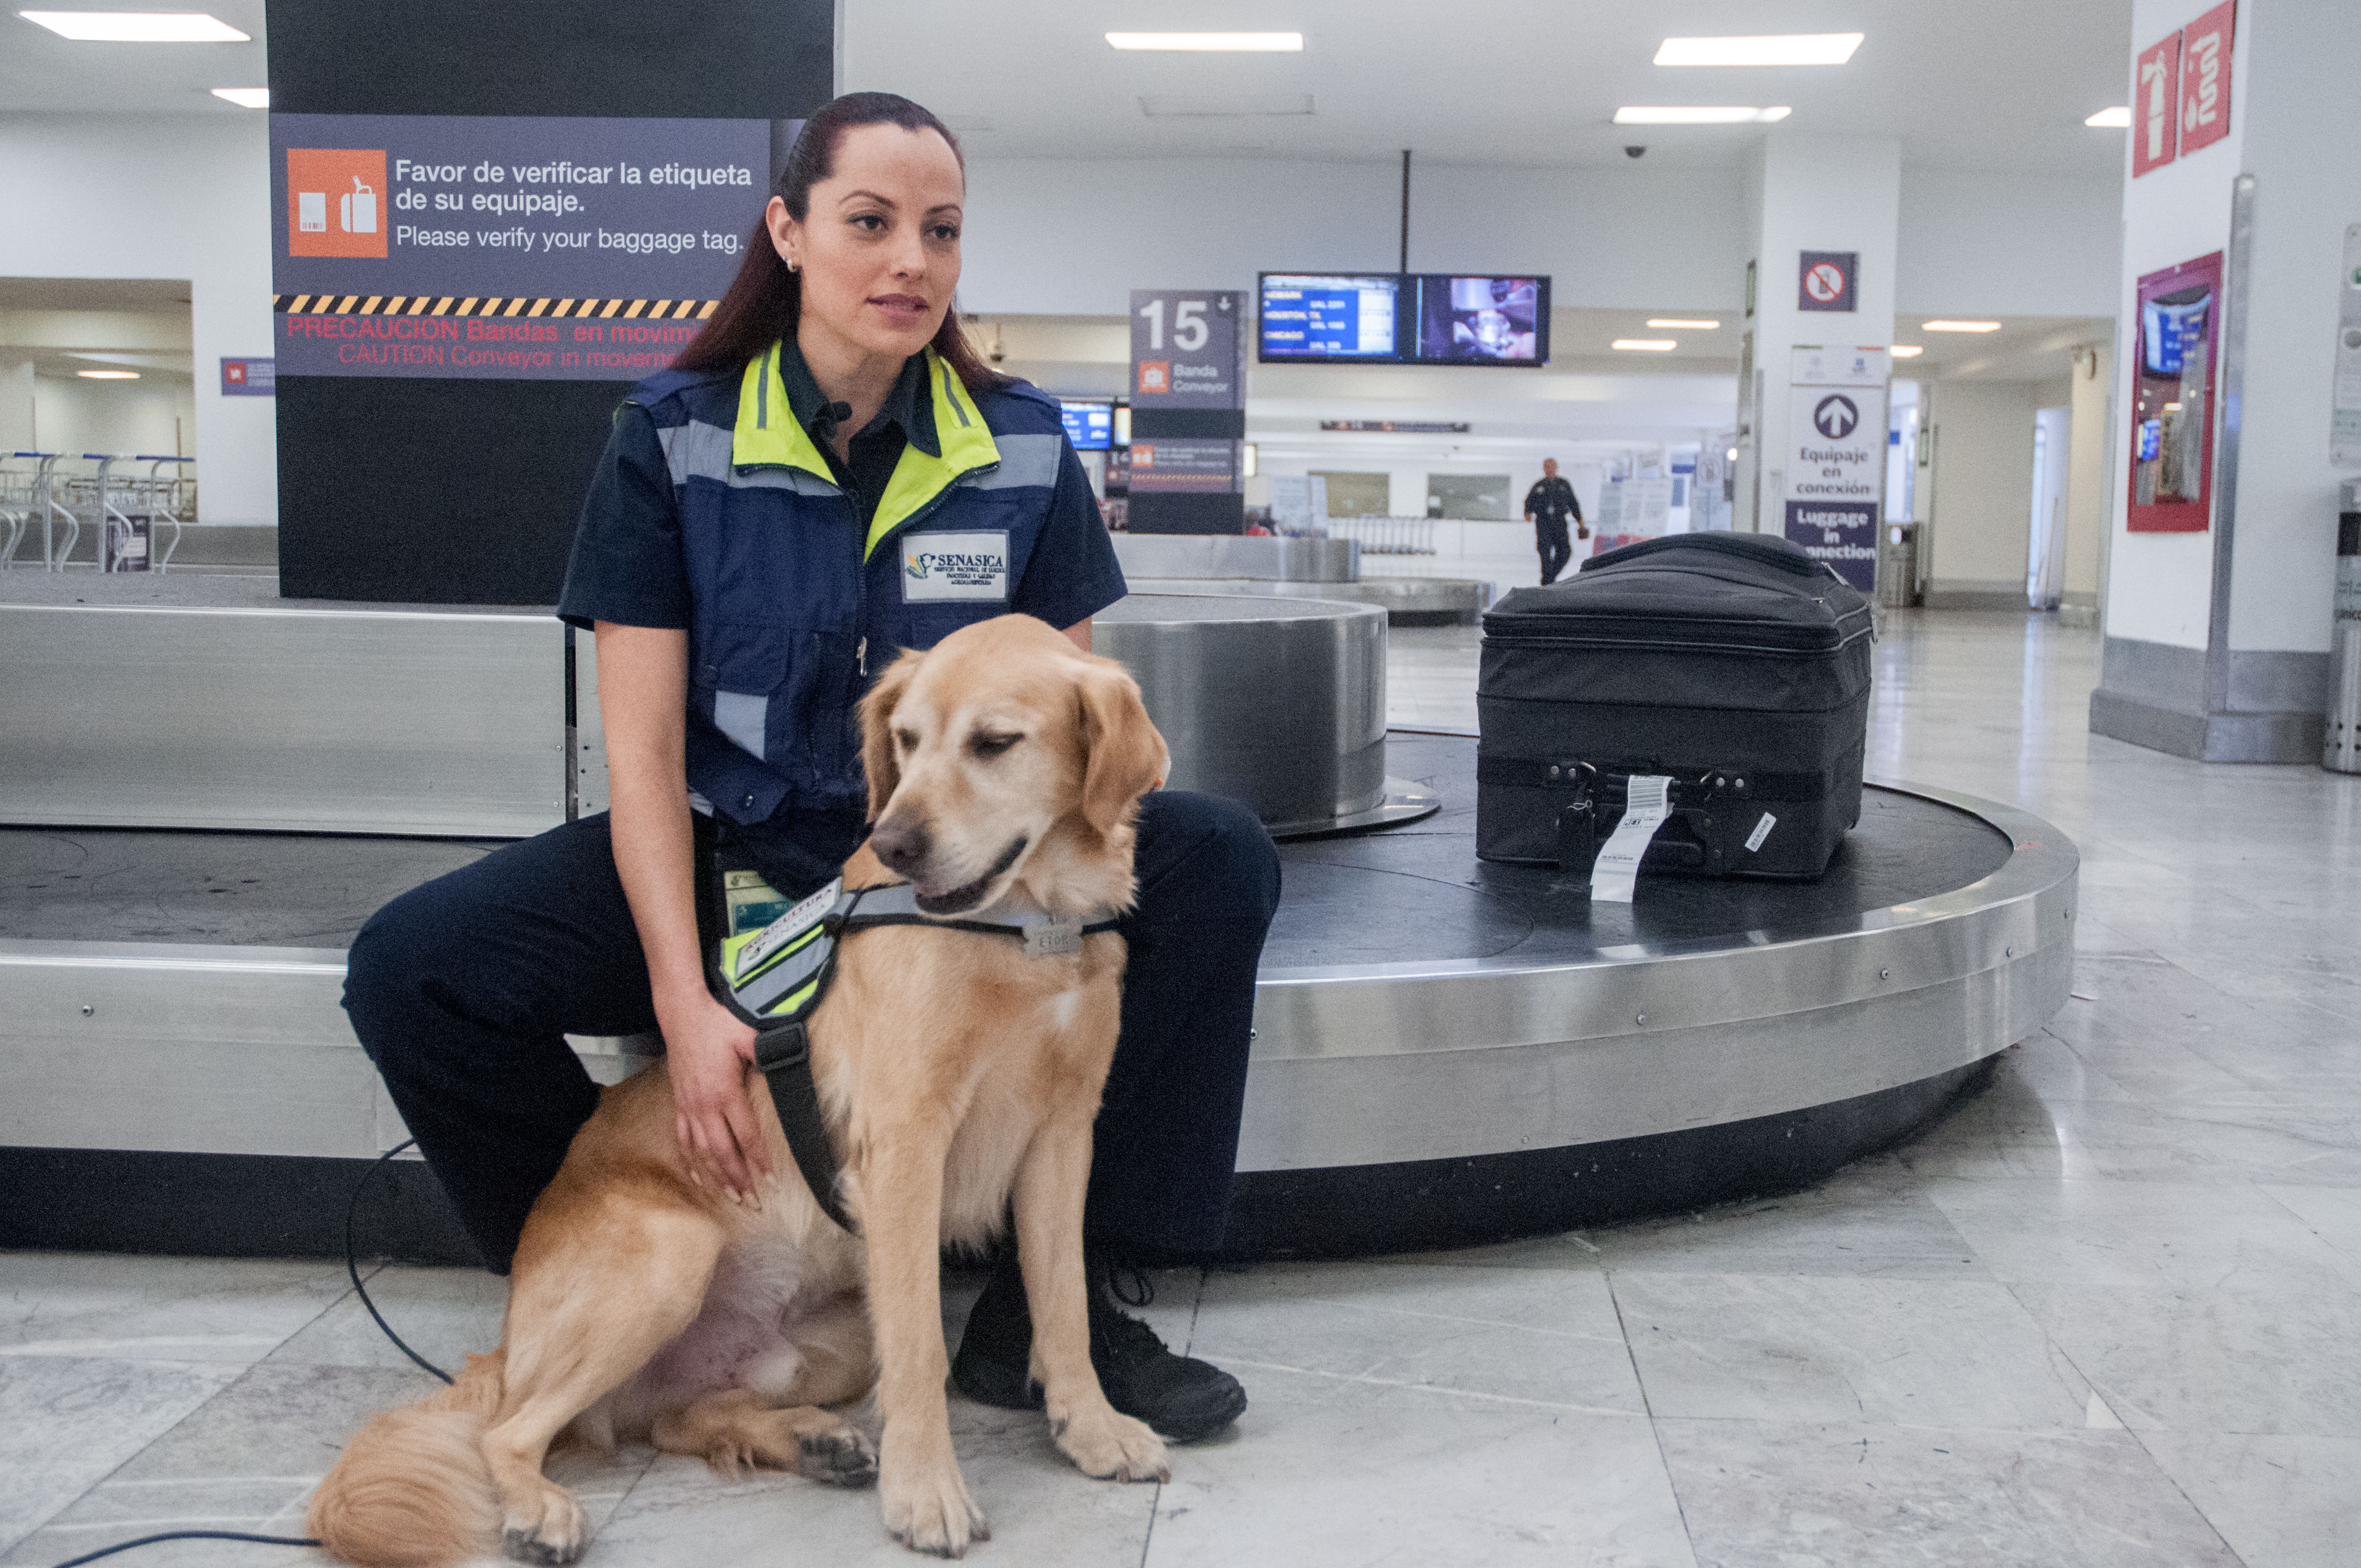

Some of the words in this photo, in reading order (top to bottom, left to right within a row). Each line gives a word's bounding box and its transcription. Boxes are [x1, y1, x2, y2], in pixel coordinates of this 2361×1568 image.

[396, 159, 467, 182] Favor
[473, 160, 504, 183] de
[511, 162, 613, 185] verificar
[621, 163, 641, 185] la
[649, 164, 752, 188] etiqueta
[395, 188, 427, 210] de
[435, 193, 463, 211] su
[472, 191, 585, 216] equipaje.
[397, 225, 469, 247] Please
[477, 226, 536, 252] verify
[542, 232, 592, 252] your
[599, 229, 696, 254] baggage
[702, 230, 744, 255] tag.
[287, 313, 459, 341] PRECAUCIÓN
[467, 318, 559, 342] Bandas
[574, 324, 603, 343] en
[611, 322, 700, 344] movimi
[1140, 299, 1209, 351] 15
[339, 343, 445, 365] CAUTION
[451, 344, 554, 371] Conveyor
[561, 349, 581, 366] in
[586, 351, 679, 369] moveme
[1173, 363, 1218, 378] Banda
[1173, 380, 1228, 394] Conveyor
[1800, 448, 1868, 465] Equipaje
[1822, 468, 1841, 478] en
[1796, 480, 1871, 495] conexión
[1797, 508, 1868, 528] Luggage
[1823, 528, 1840, 545] in
[938, 554, 1003, 567] SENASICA
[1806, 543, 1876, 560] nnection
[745, 887, 833, 951] AGRICULTURA
